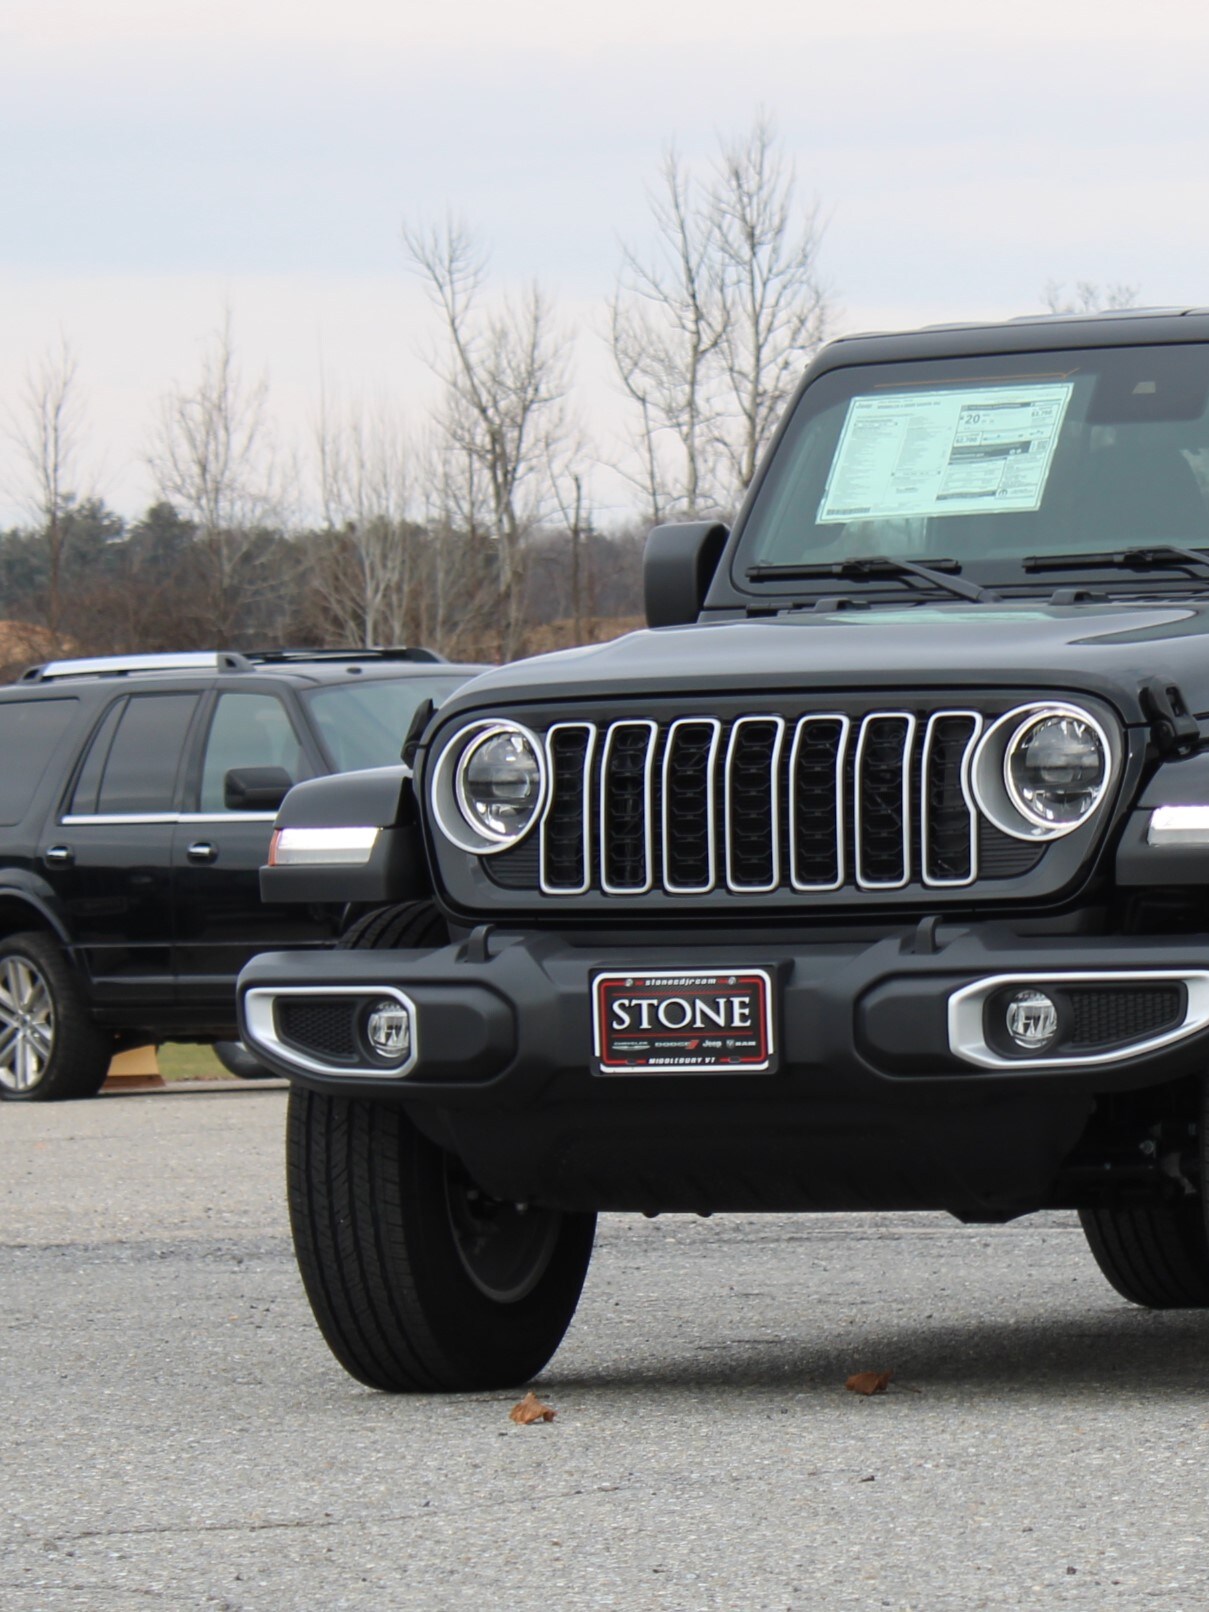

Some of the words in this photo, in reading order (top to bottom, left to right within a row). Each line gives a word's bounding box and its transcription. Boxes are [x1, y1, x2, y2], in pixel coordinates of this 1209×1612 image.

[965, 413, 981, 424] 20
[612, 996, 752, 1030] STONE
[702, 1039, 722, 1048] Jeep
[648, 1056, 703, 1064] MIDDLEBURY
